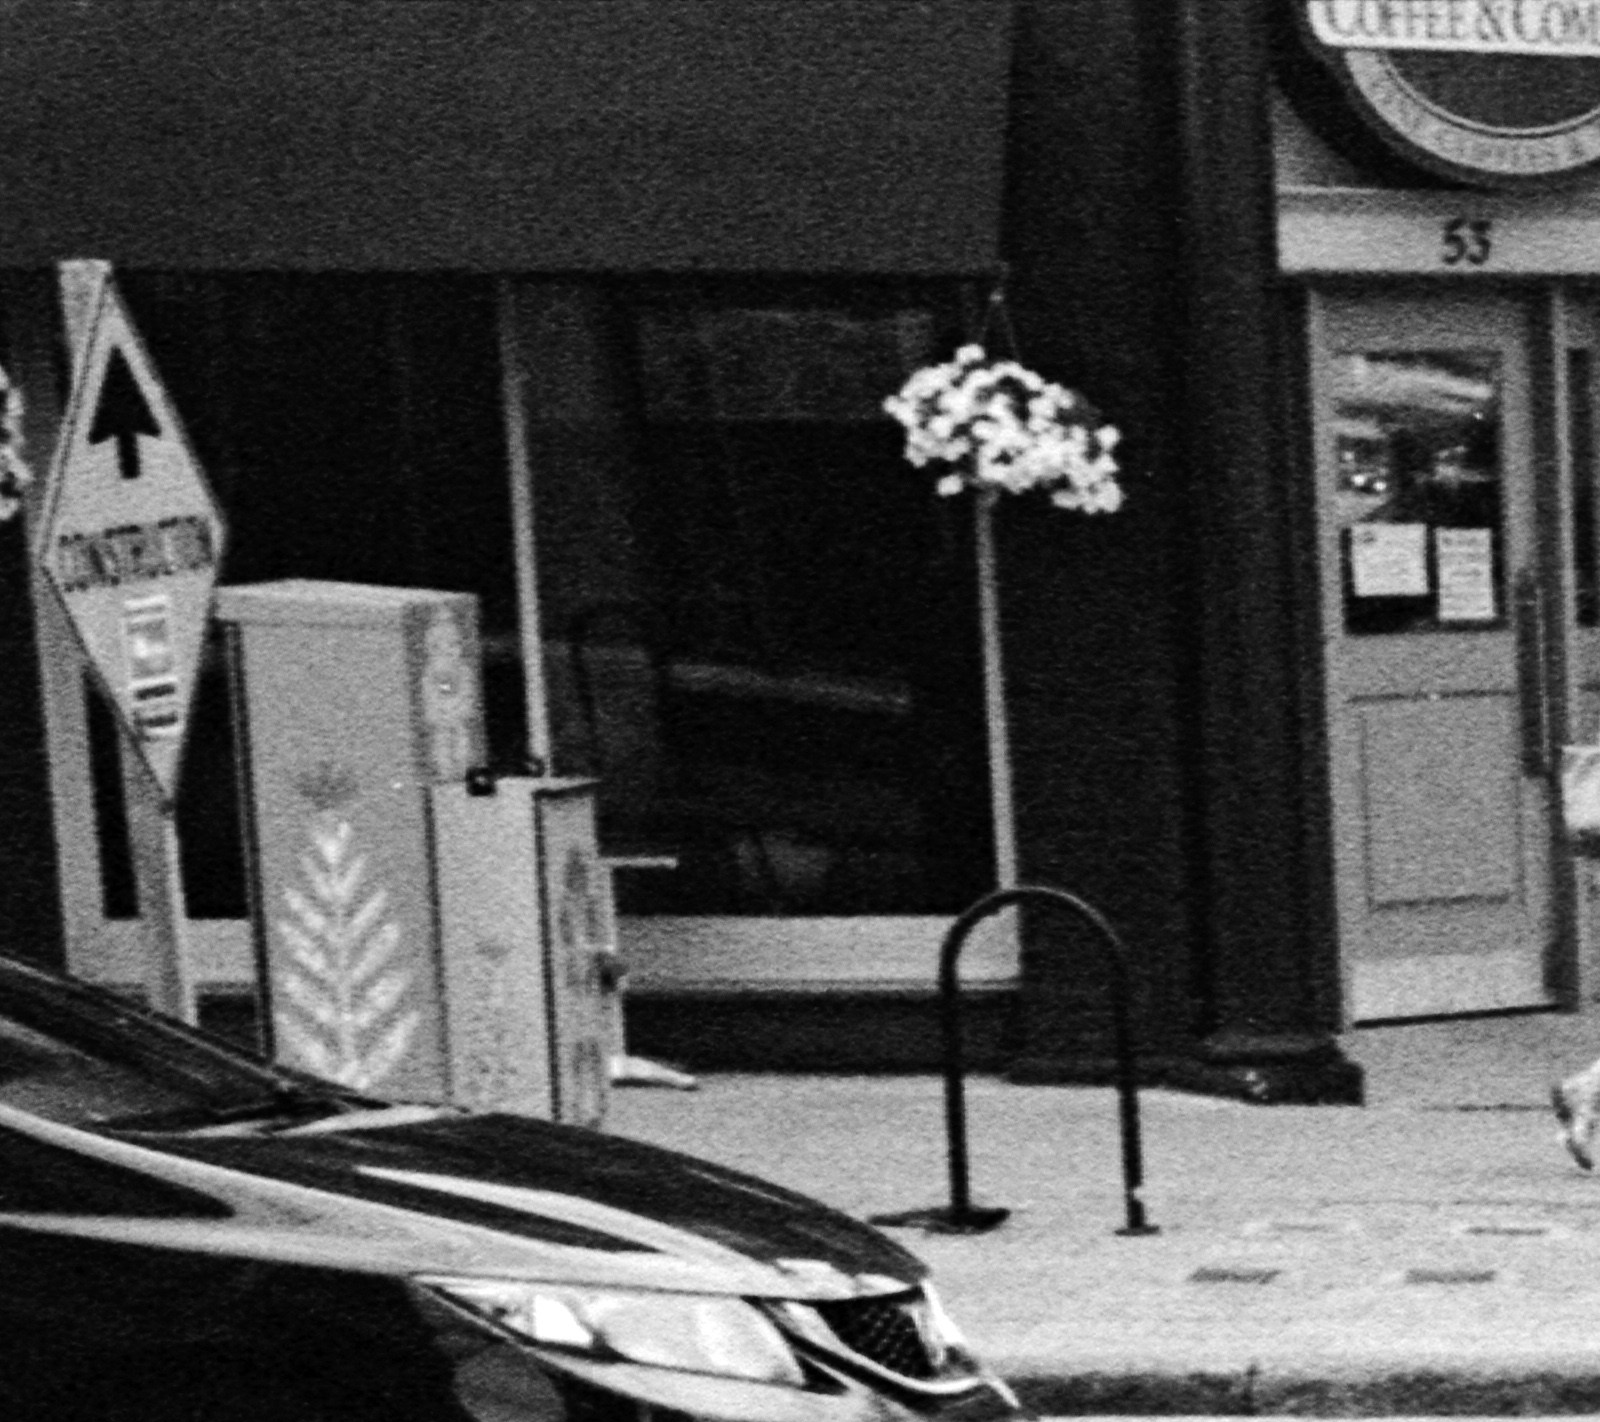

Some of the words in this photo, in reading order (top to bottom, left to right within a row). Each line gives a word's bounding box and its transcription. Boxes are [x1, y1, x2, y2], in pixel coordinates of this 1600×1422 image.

[1324, 0, 1466, 41] COFFEE
[1475, 0, 1508, 43] &
[1442, 217, 1492, 266] 53
